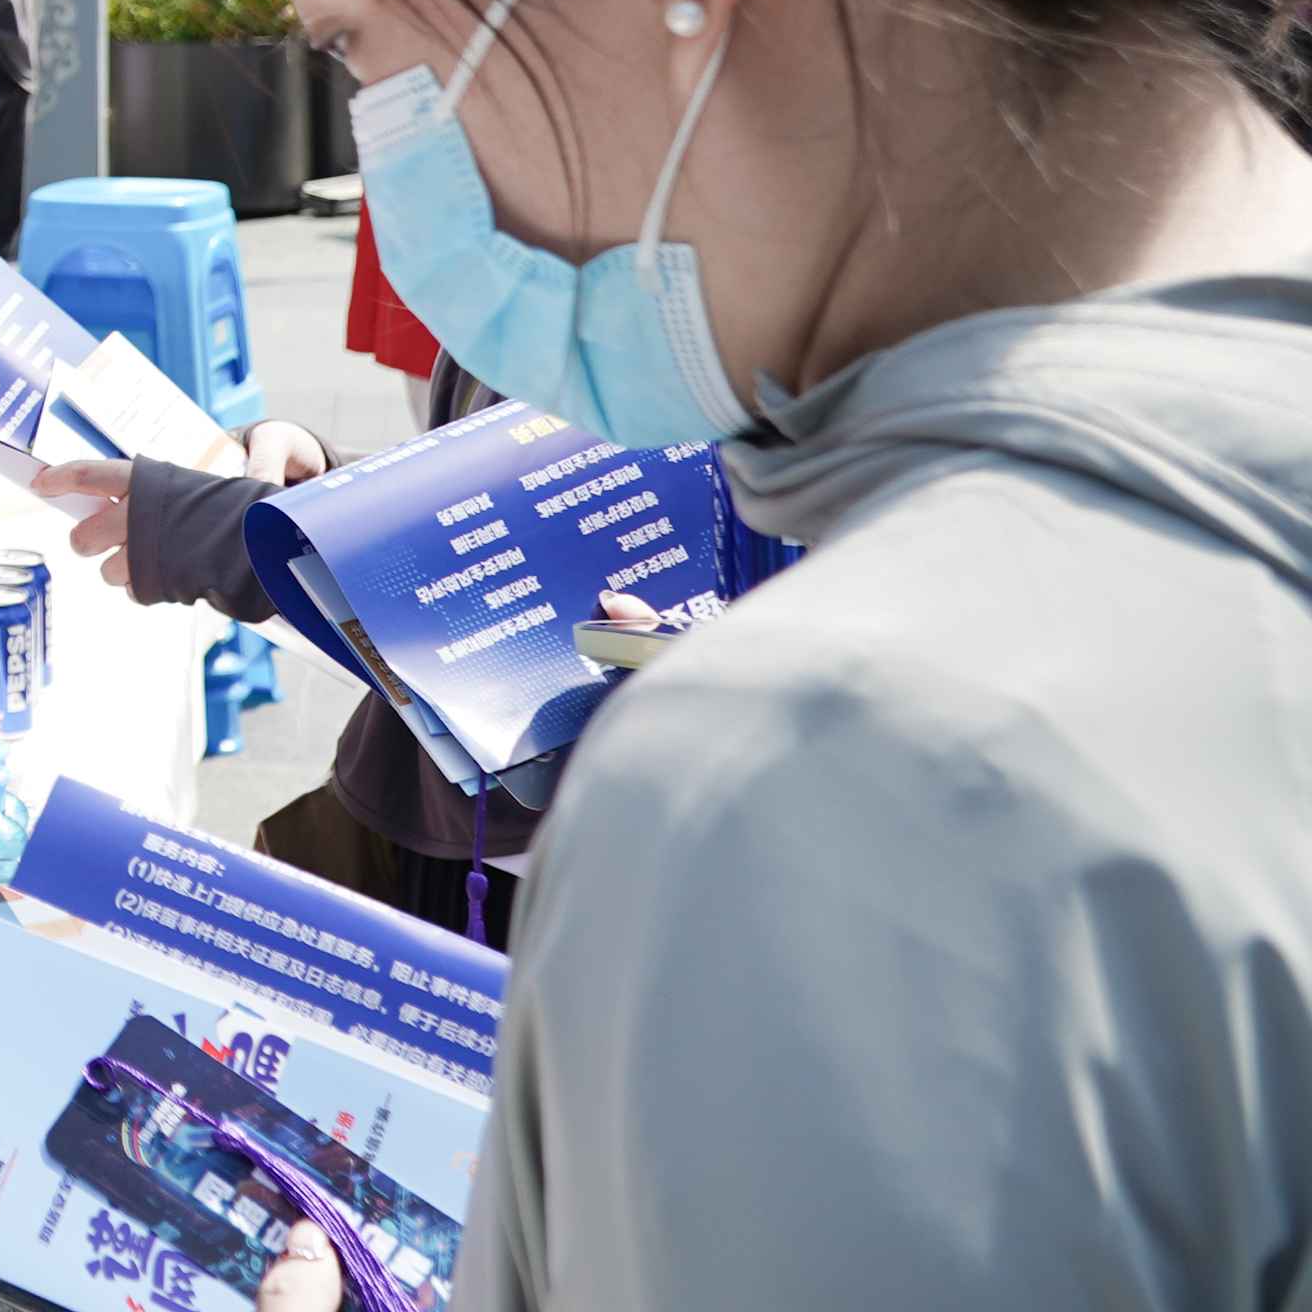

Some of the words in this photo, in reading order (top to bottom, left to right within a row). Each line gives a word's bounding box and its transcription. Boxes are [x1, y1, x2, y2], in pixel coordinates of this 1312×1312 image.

[436, 491, 496, 528] 其他服务
[533, 462, 644, 520] 网络安全应急演练
[577, 489, 660, 536] 等级保护测评
[450, 518, 511, 557] 漏洞扫描
[615, 516, 677, 553] 渗透测试
[414, 545, 527, 606] 网络安全风险评估
[605, 543, 691, 592] 网络安全培训
[483, 574, 543, 612] 攻防演练
[433, 600, 559, 666] 网络安全加固和修复
[6, 623, 26, 714] PEPSI
